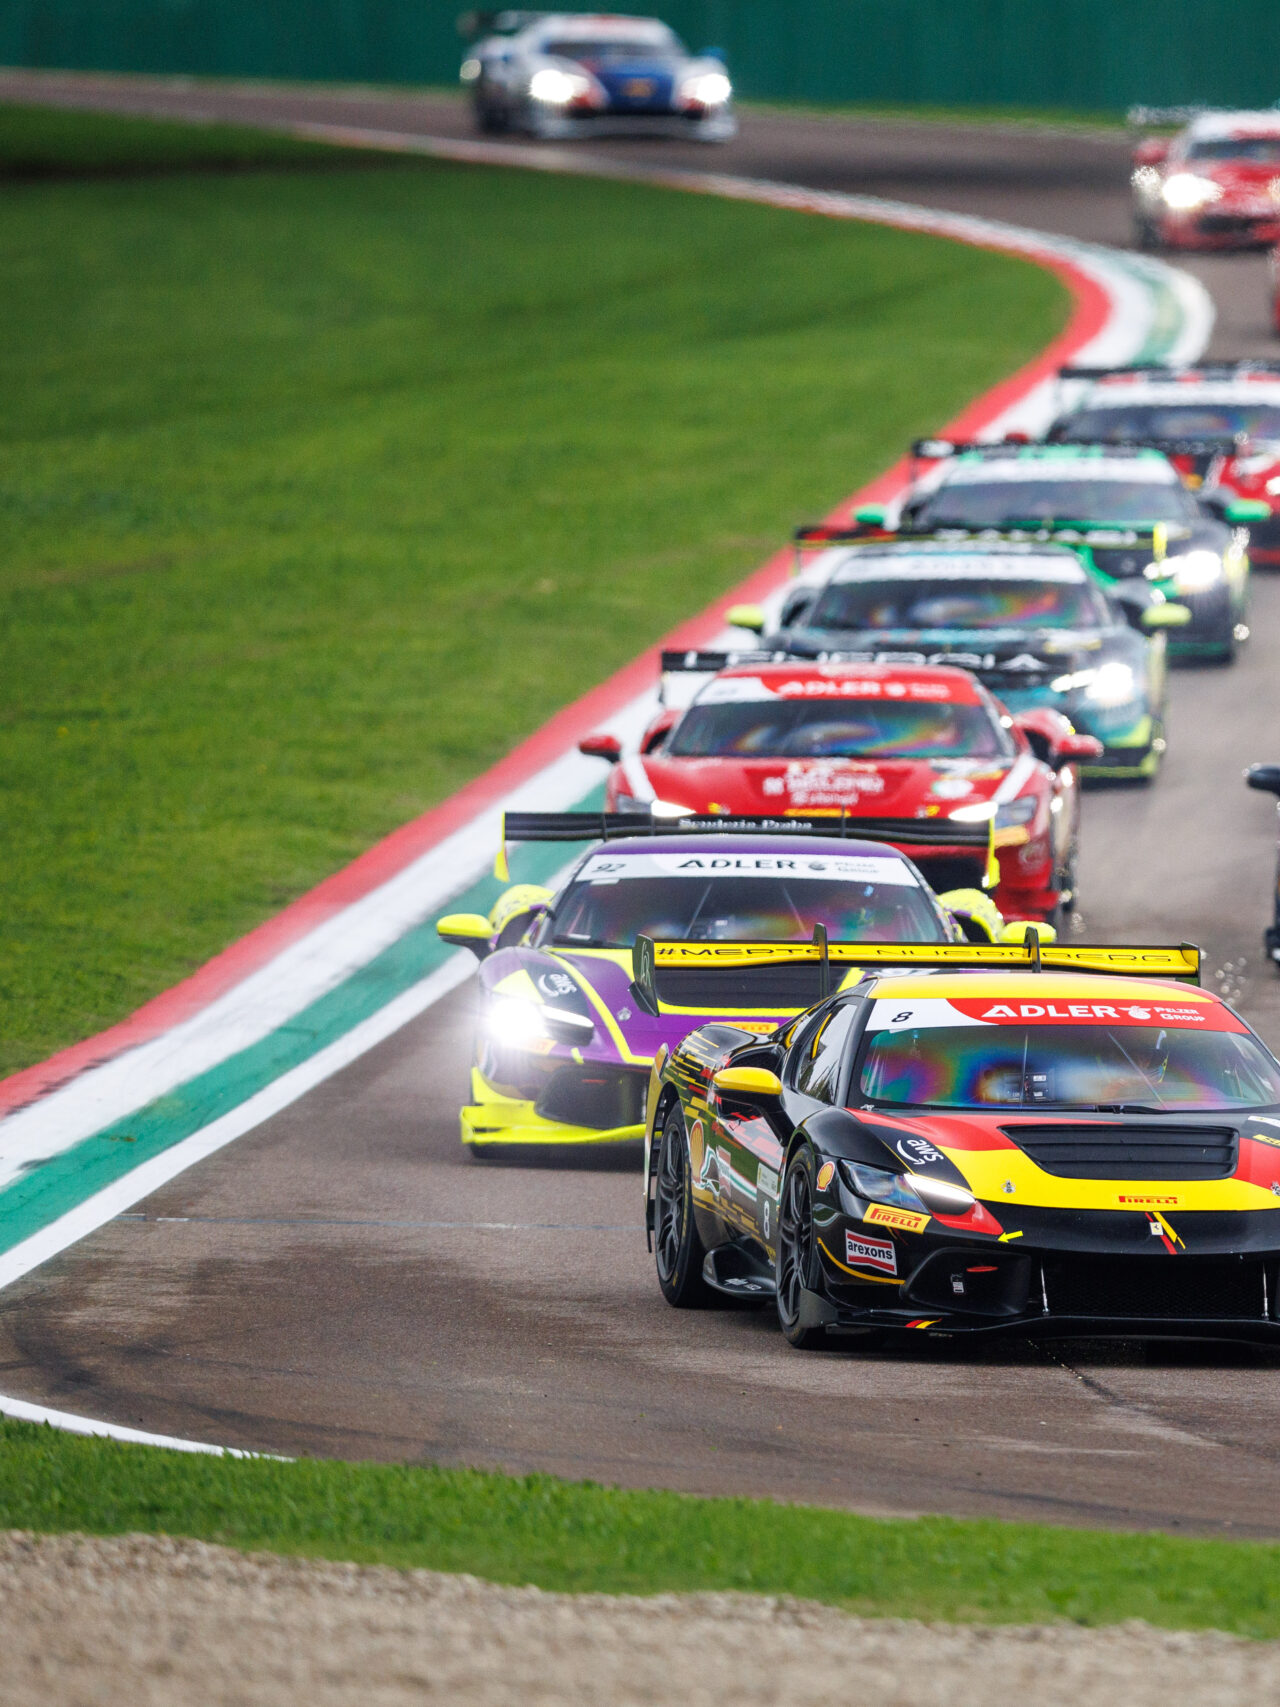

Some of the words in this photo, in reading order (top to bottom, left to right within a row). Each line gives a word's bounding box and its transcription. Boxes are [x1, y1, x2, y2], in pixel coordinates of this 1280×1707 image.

[676, 858, 798, 870] ADLER
[891, 1011, 914, 1023] 8
[981, 1004, 1122, 1018] ADLER
[1154, 1006, 1199, 1015] PELZER
[1161, 1013, 1206, 1022] GROUP
[907, 1139, 944, 1162] aws
[1118, 1195, 1178, 1204] PIRELLI
[763, 1200, 771, 1240] 8
[870, 1207, 923, 1229] PIRELLI
[847, 1240, 894, 1260] arexons
